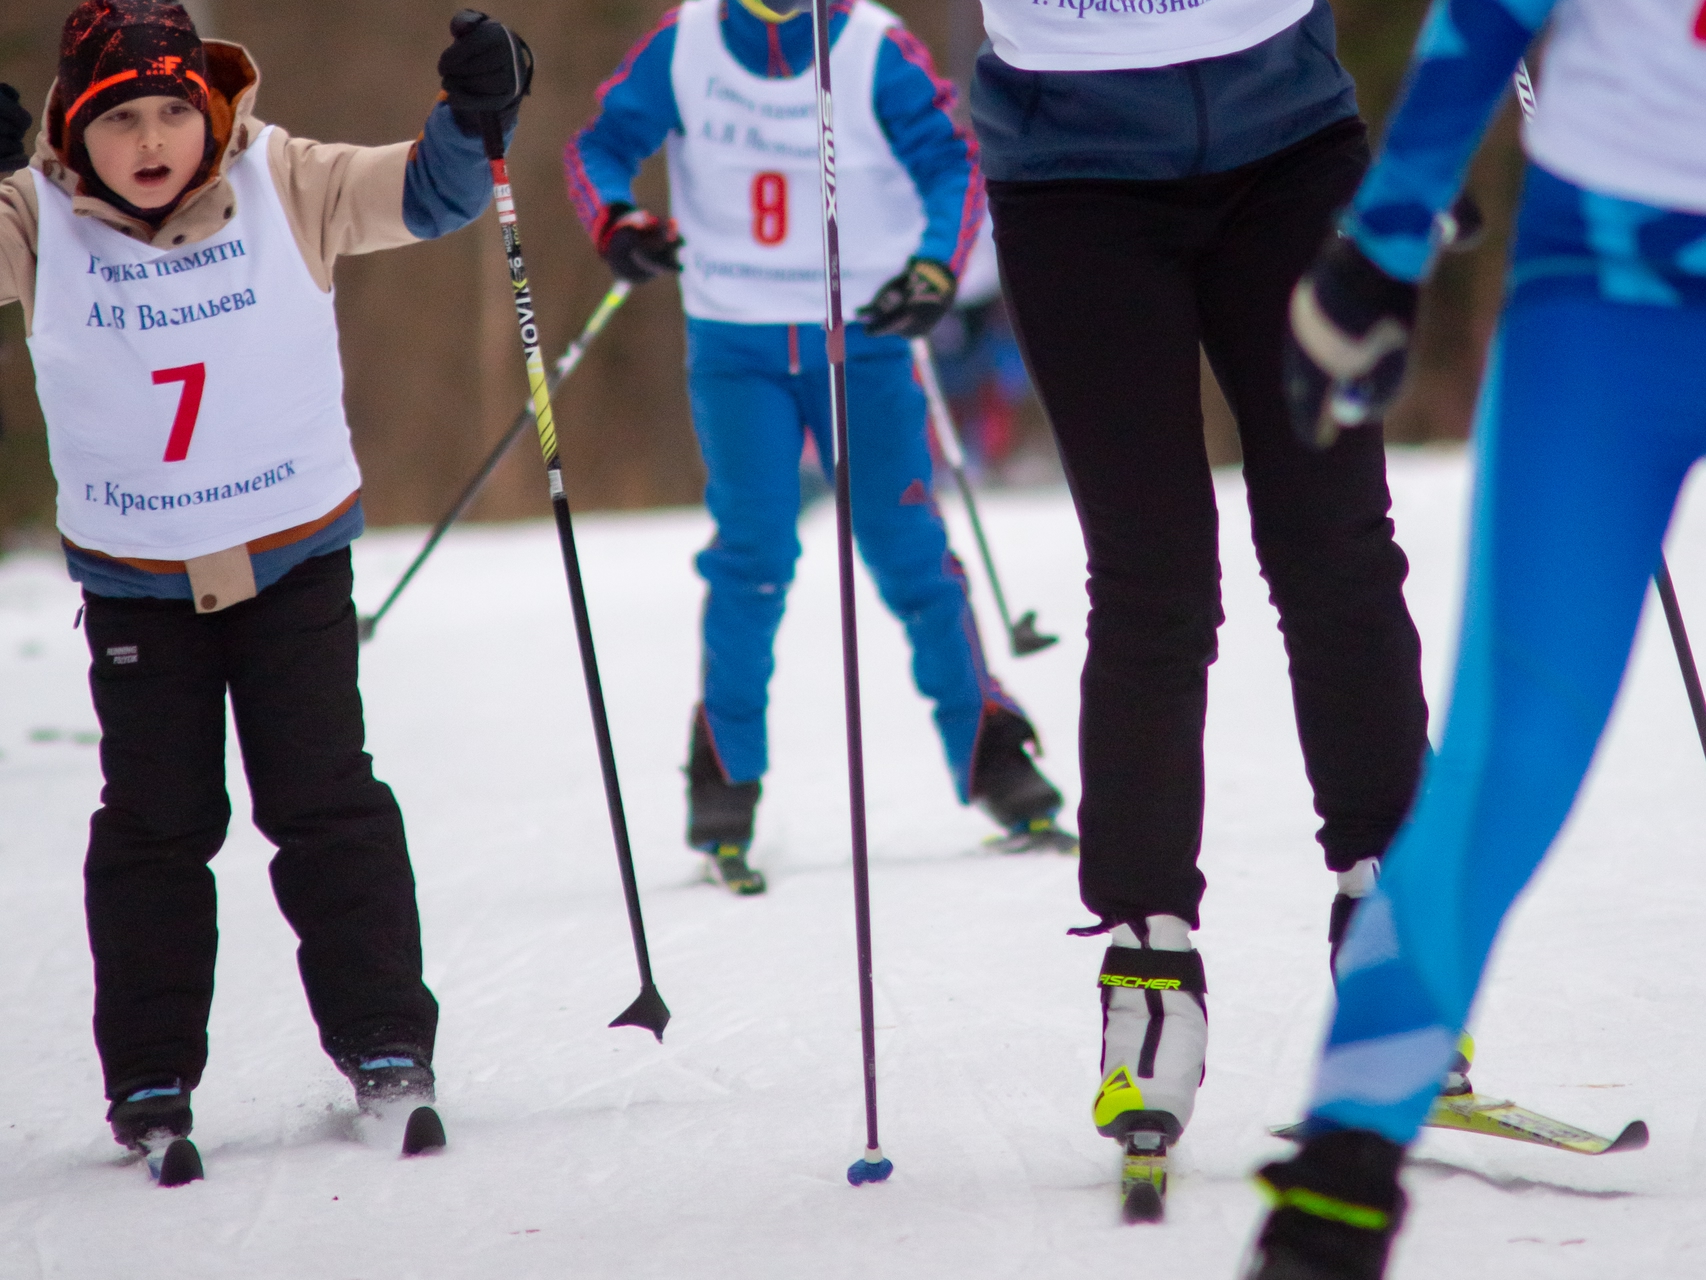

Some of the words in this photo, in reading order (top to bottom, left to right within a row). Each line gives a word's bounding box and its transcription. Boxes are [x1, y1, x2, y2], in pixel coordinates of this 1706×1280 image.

[750, 170, 789, 247] 8
[154, 238, 246, 277] памяти
[136, 287, 257, 331] Васильева
[151, 362, 206, 463] 7
[84, 483, 98, 503] г.
[104, 460, 296, 516] Краснознаменск
